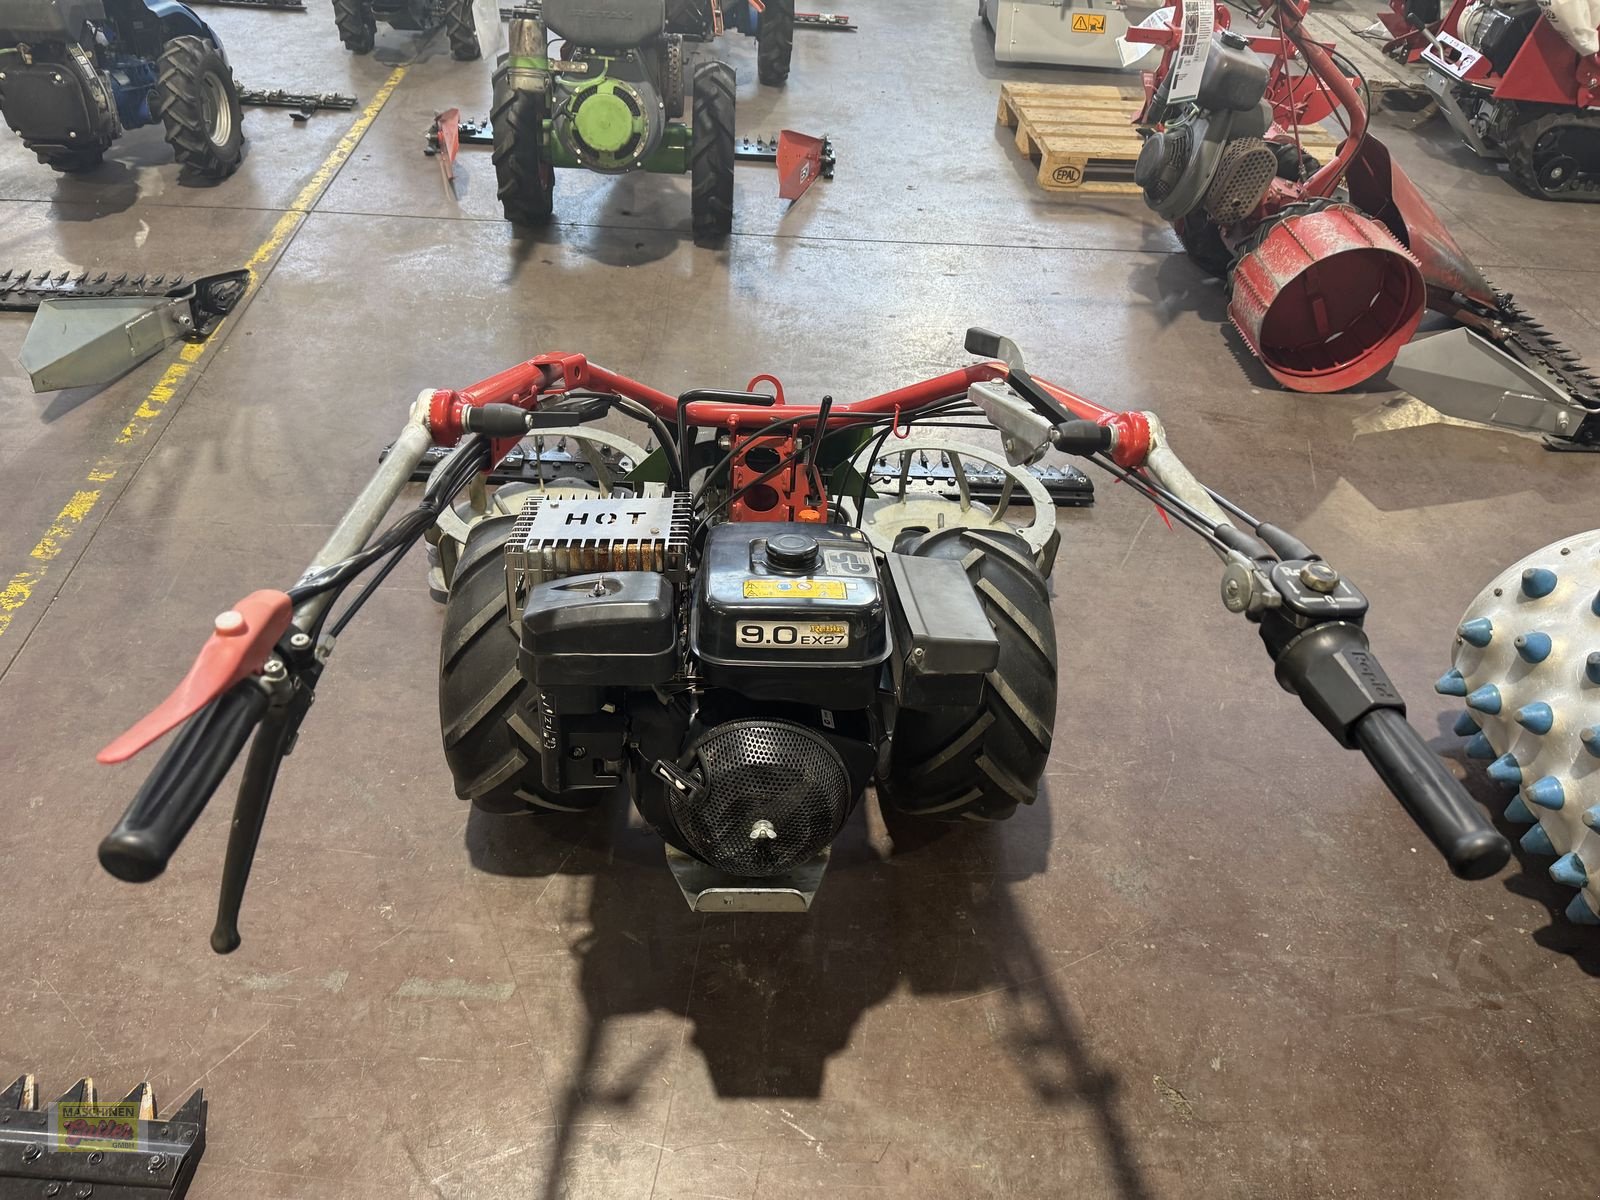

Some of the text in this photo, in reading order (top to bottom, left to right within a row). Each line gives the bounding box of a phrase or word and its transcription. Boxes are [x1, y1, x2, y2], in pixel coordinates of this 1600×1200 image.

[1056, 169, 1077, 181] EPAL
[565, 512, 646, 525] HOT
[741, 625, 798, 645] 9.0
[800, 635, 845, 645] EX27
